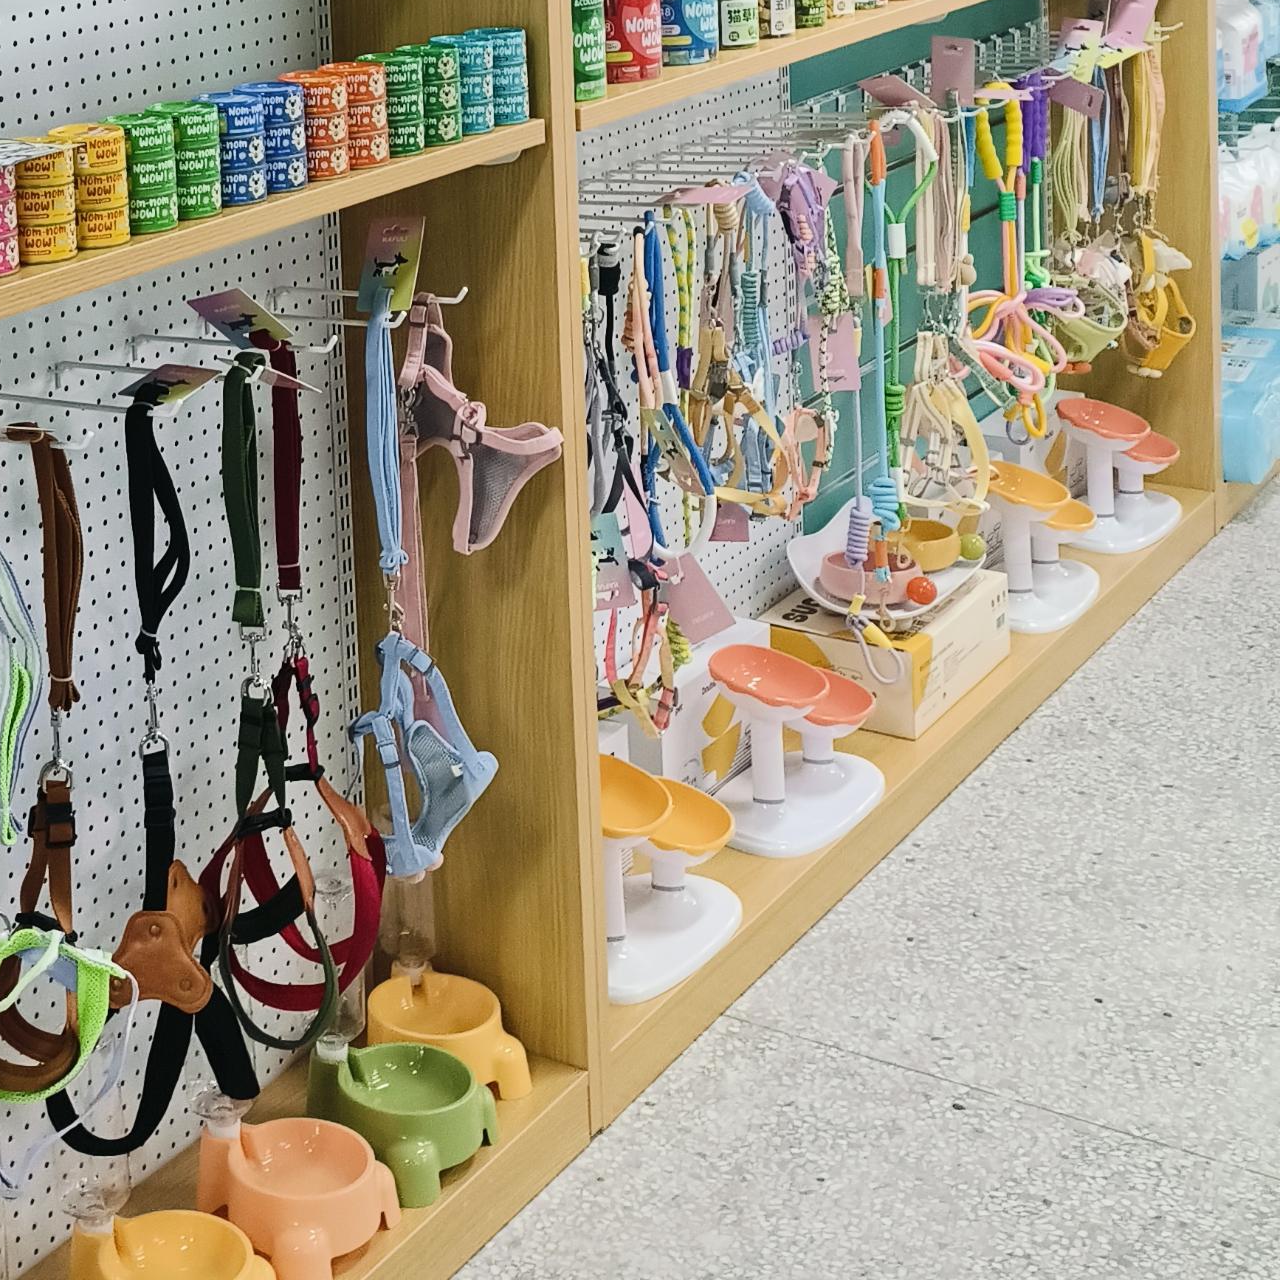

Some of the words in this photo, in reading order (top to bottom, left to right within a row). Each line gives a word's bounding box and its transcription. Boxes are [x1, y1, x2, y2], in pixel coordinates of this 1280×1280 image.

[87, 184, 116, 197] WOW!
[24, 200, 55, 212] WOW!
[131, 196, 169, 208] om-nom
[87, 222, 117, 234] WOW!
[25, 237, 56, 249] WOW!
